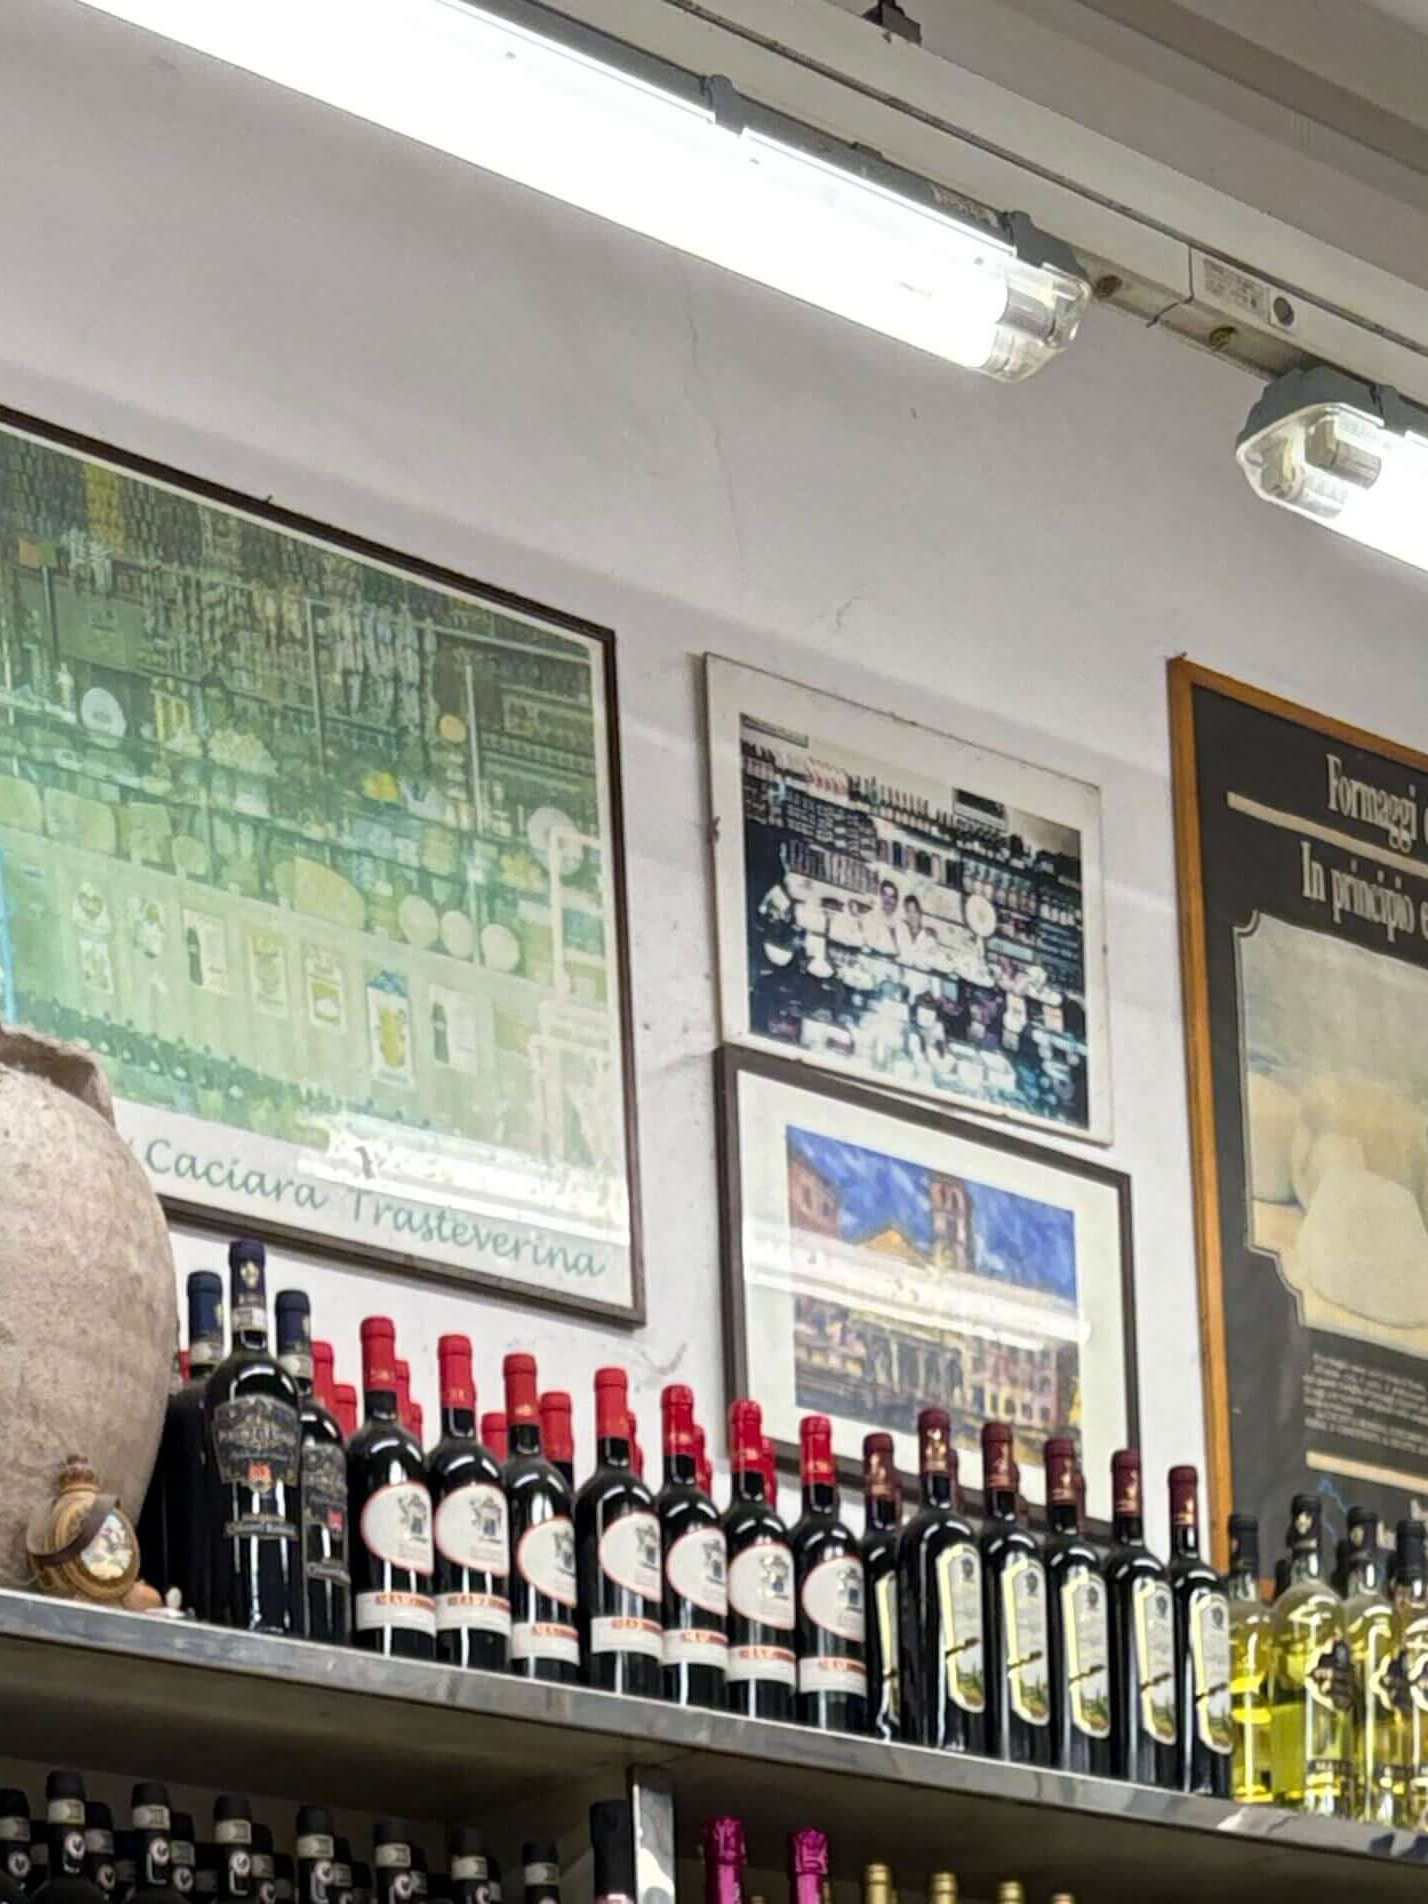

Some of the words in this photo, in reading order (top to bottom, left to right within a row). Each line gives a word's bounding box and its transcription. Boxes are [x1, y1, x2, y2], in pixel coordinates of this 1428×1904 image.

[1327, 753, 1417, 853] Formaggi
[1301, 841, 1326, 902] In
[1331, 859, 1415, 943] principio
[145, 1140, 327, 1212] Caciara
[346, 1184, 607, 1279] Trasteverina
